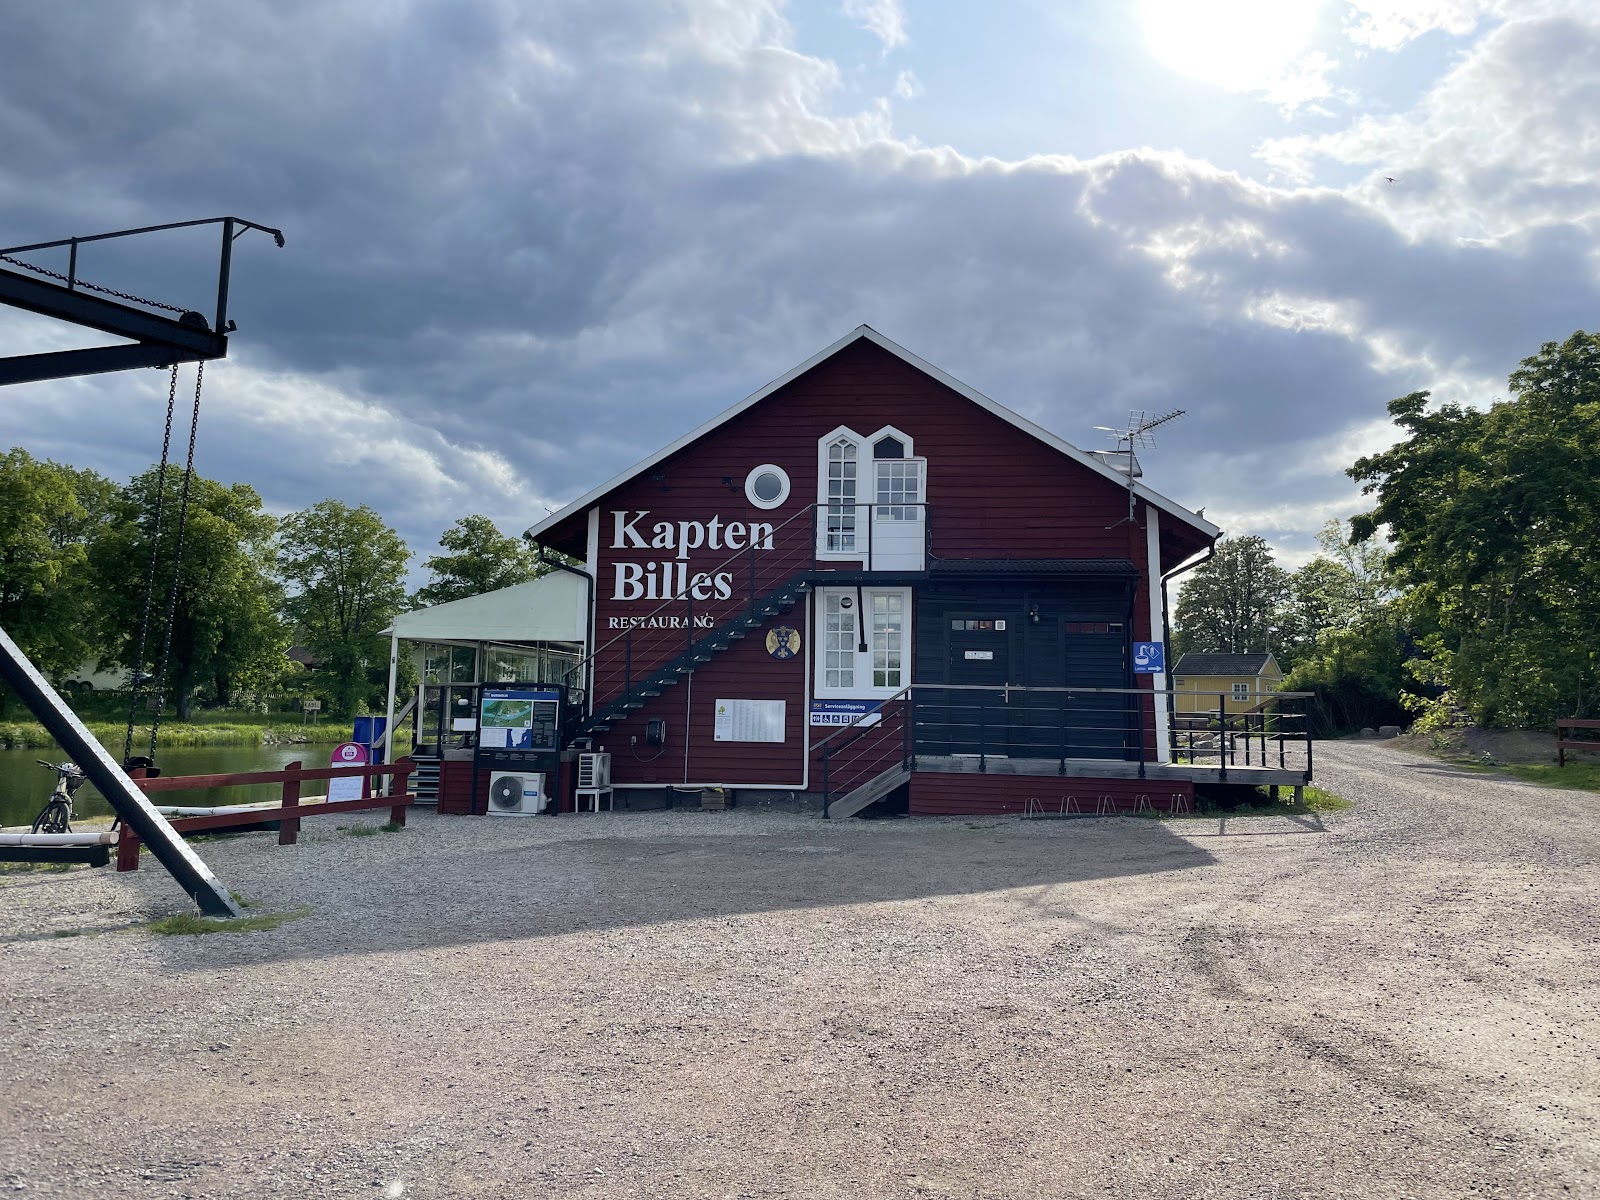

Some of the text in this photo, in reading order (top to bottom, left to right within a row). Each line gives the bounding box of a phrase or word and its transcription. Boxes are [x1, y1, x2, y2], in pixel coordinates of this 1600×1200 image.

[609, 510, 775, 559] Kapten
[609, 562, 733, 600] Billes
[608, 615, 714, 629] RESTAURANG
[824, 703, 866, 711] Serviceanläggning
